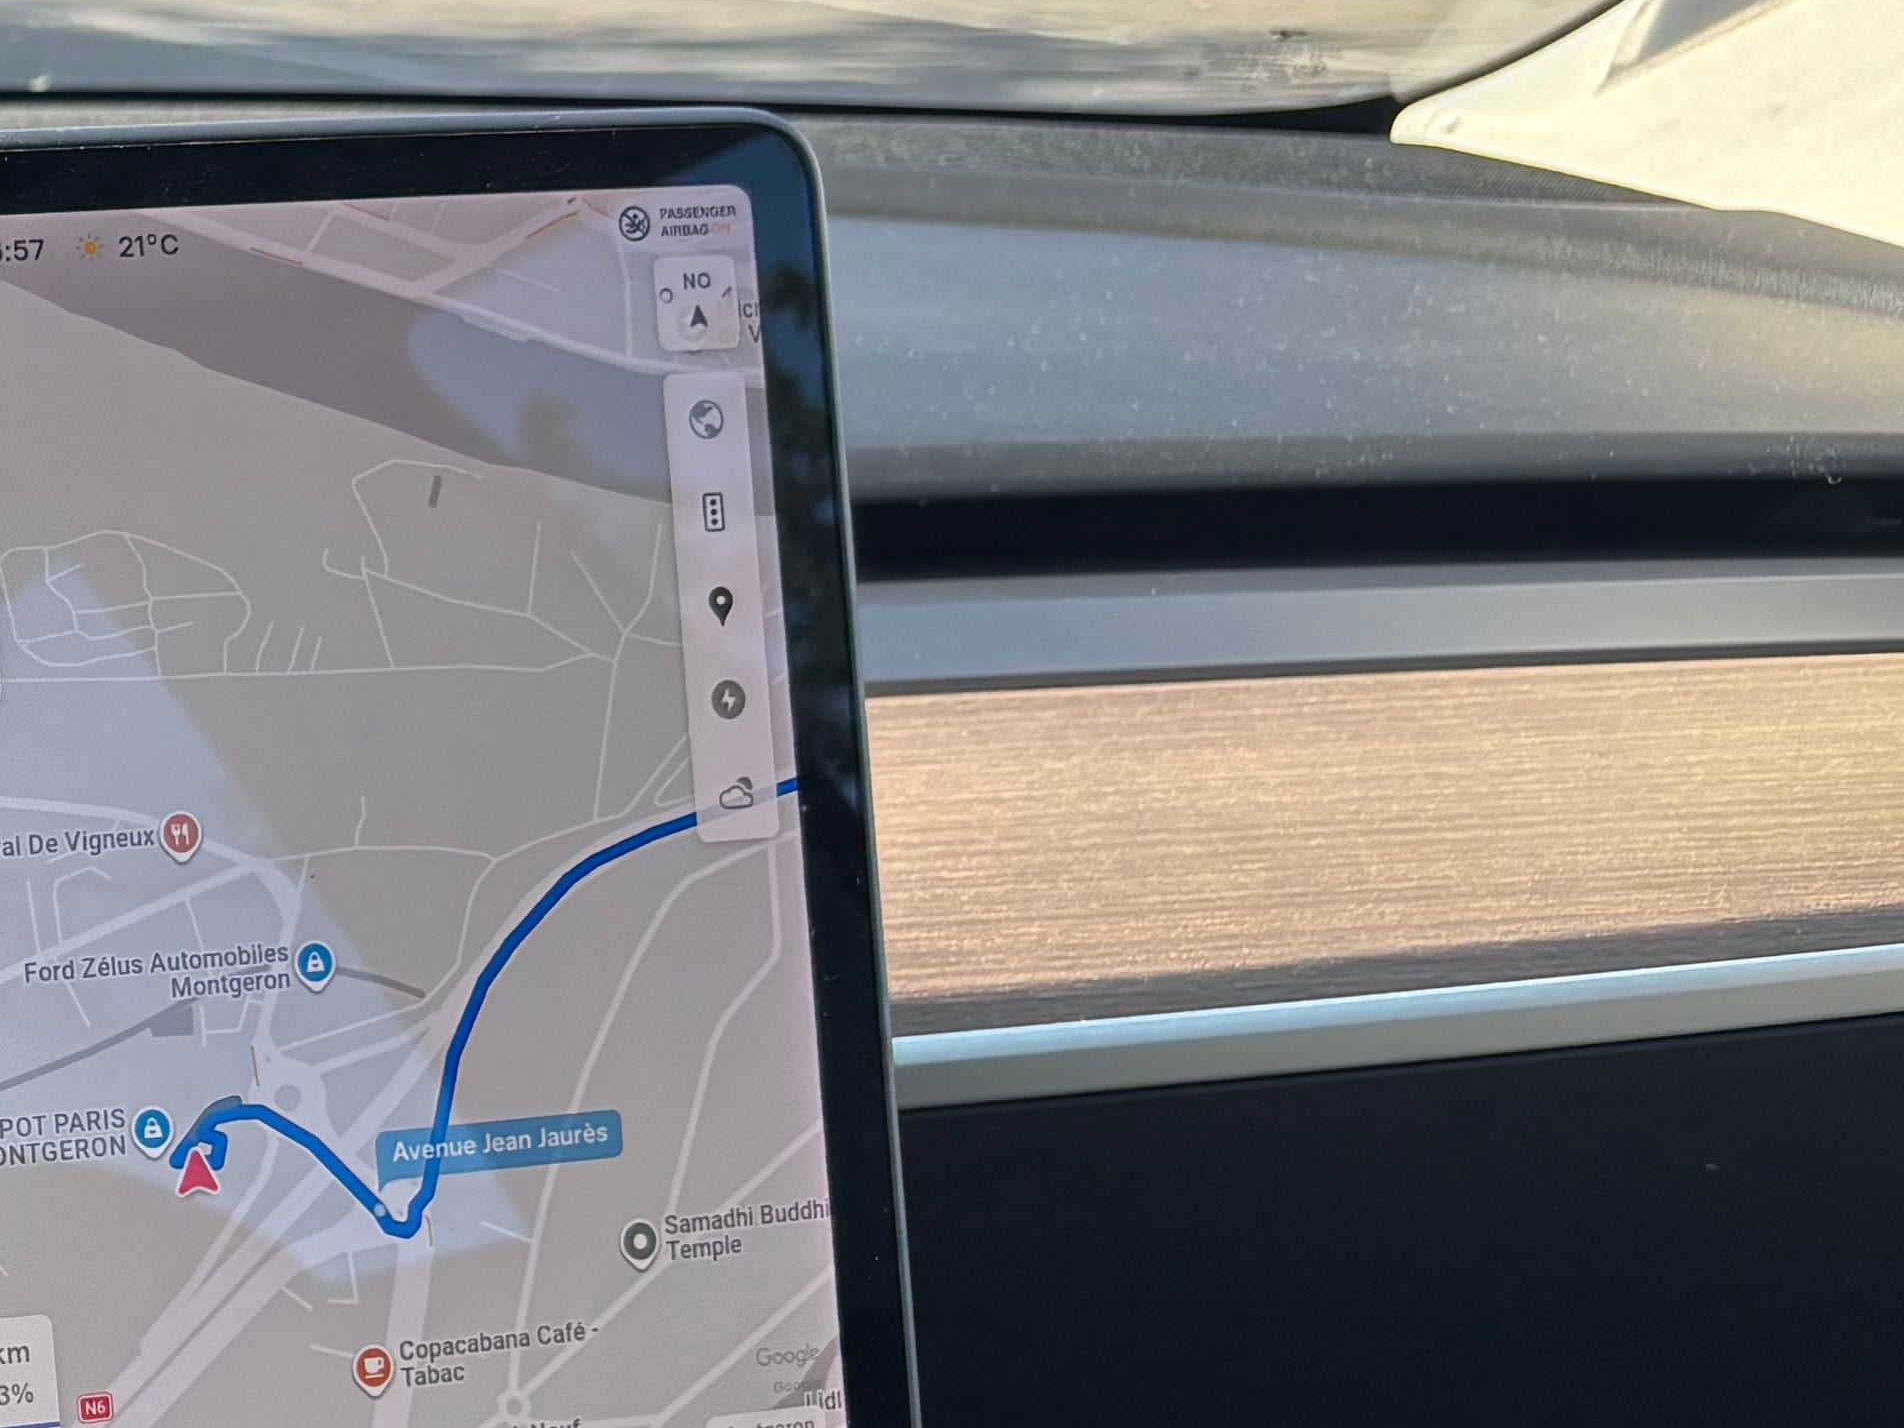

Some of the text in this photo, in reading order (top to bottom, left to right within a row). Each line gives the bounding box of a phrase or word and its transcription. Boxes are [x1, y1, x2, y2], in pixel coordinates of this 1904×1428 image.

[659, 205, 736, 219] PASSENGER
[661, 224, 709, 237] AIRBAG
[118, 233, 179, 258] 21°C
[683, 272, 711, 289] NO
[28, 834, 59, 856] De
[64, 825, 155, 856] Vigneux
[24, 943, 289, 984] Ford Zélus Automobiles
[171, 973, 291, 999] Montgeron
[54, 1109, 126, 1133] PARIS
[393, 1121, 609, 1163] Avenue Jean Jaurès
[665, 1209, 754, 1234] Samadhi
[667, 1237, 742, 1262] Temple
[399, 1330, 532, 1362] Copacabana
[537, 1322, 587, 1348] Café
[756, 1343, 819, 1366] Google
[401, 1363, 466, 1388] Tabac
[84, 1403, 106, 1416] N6
